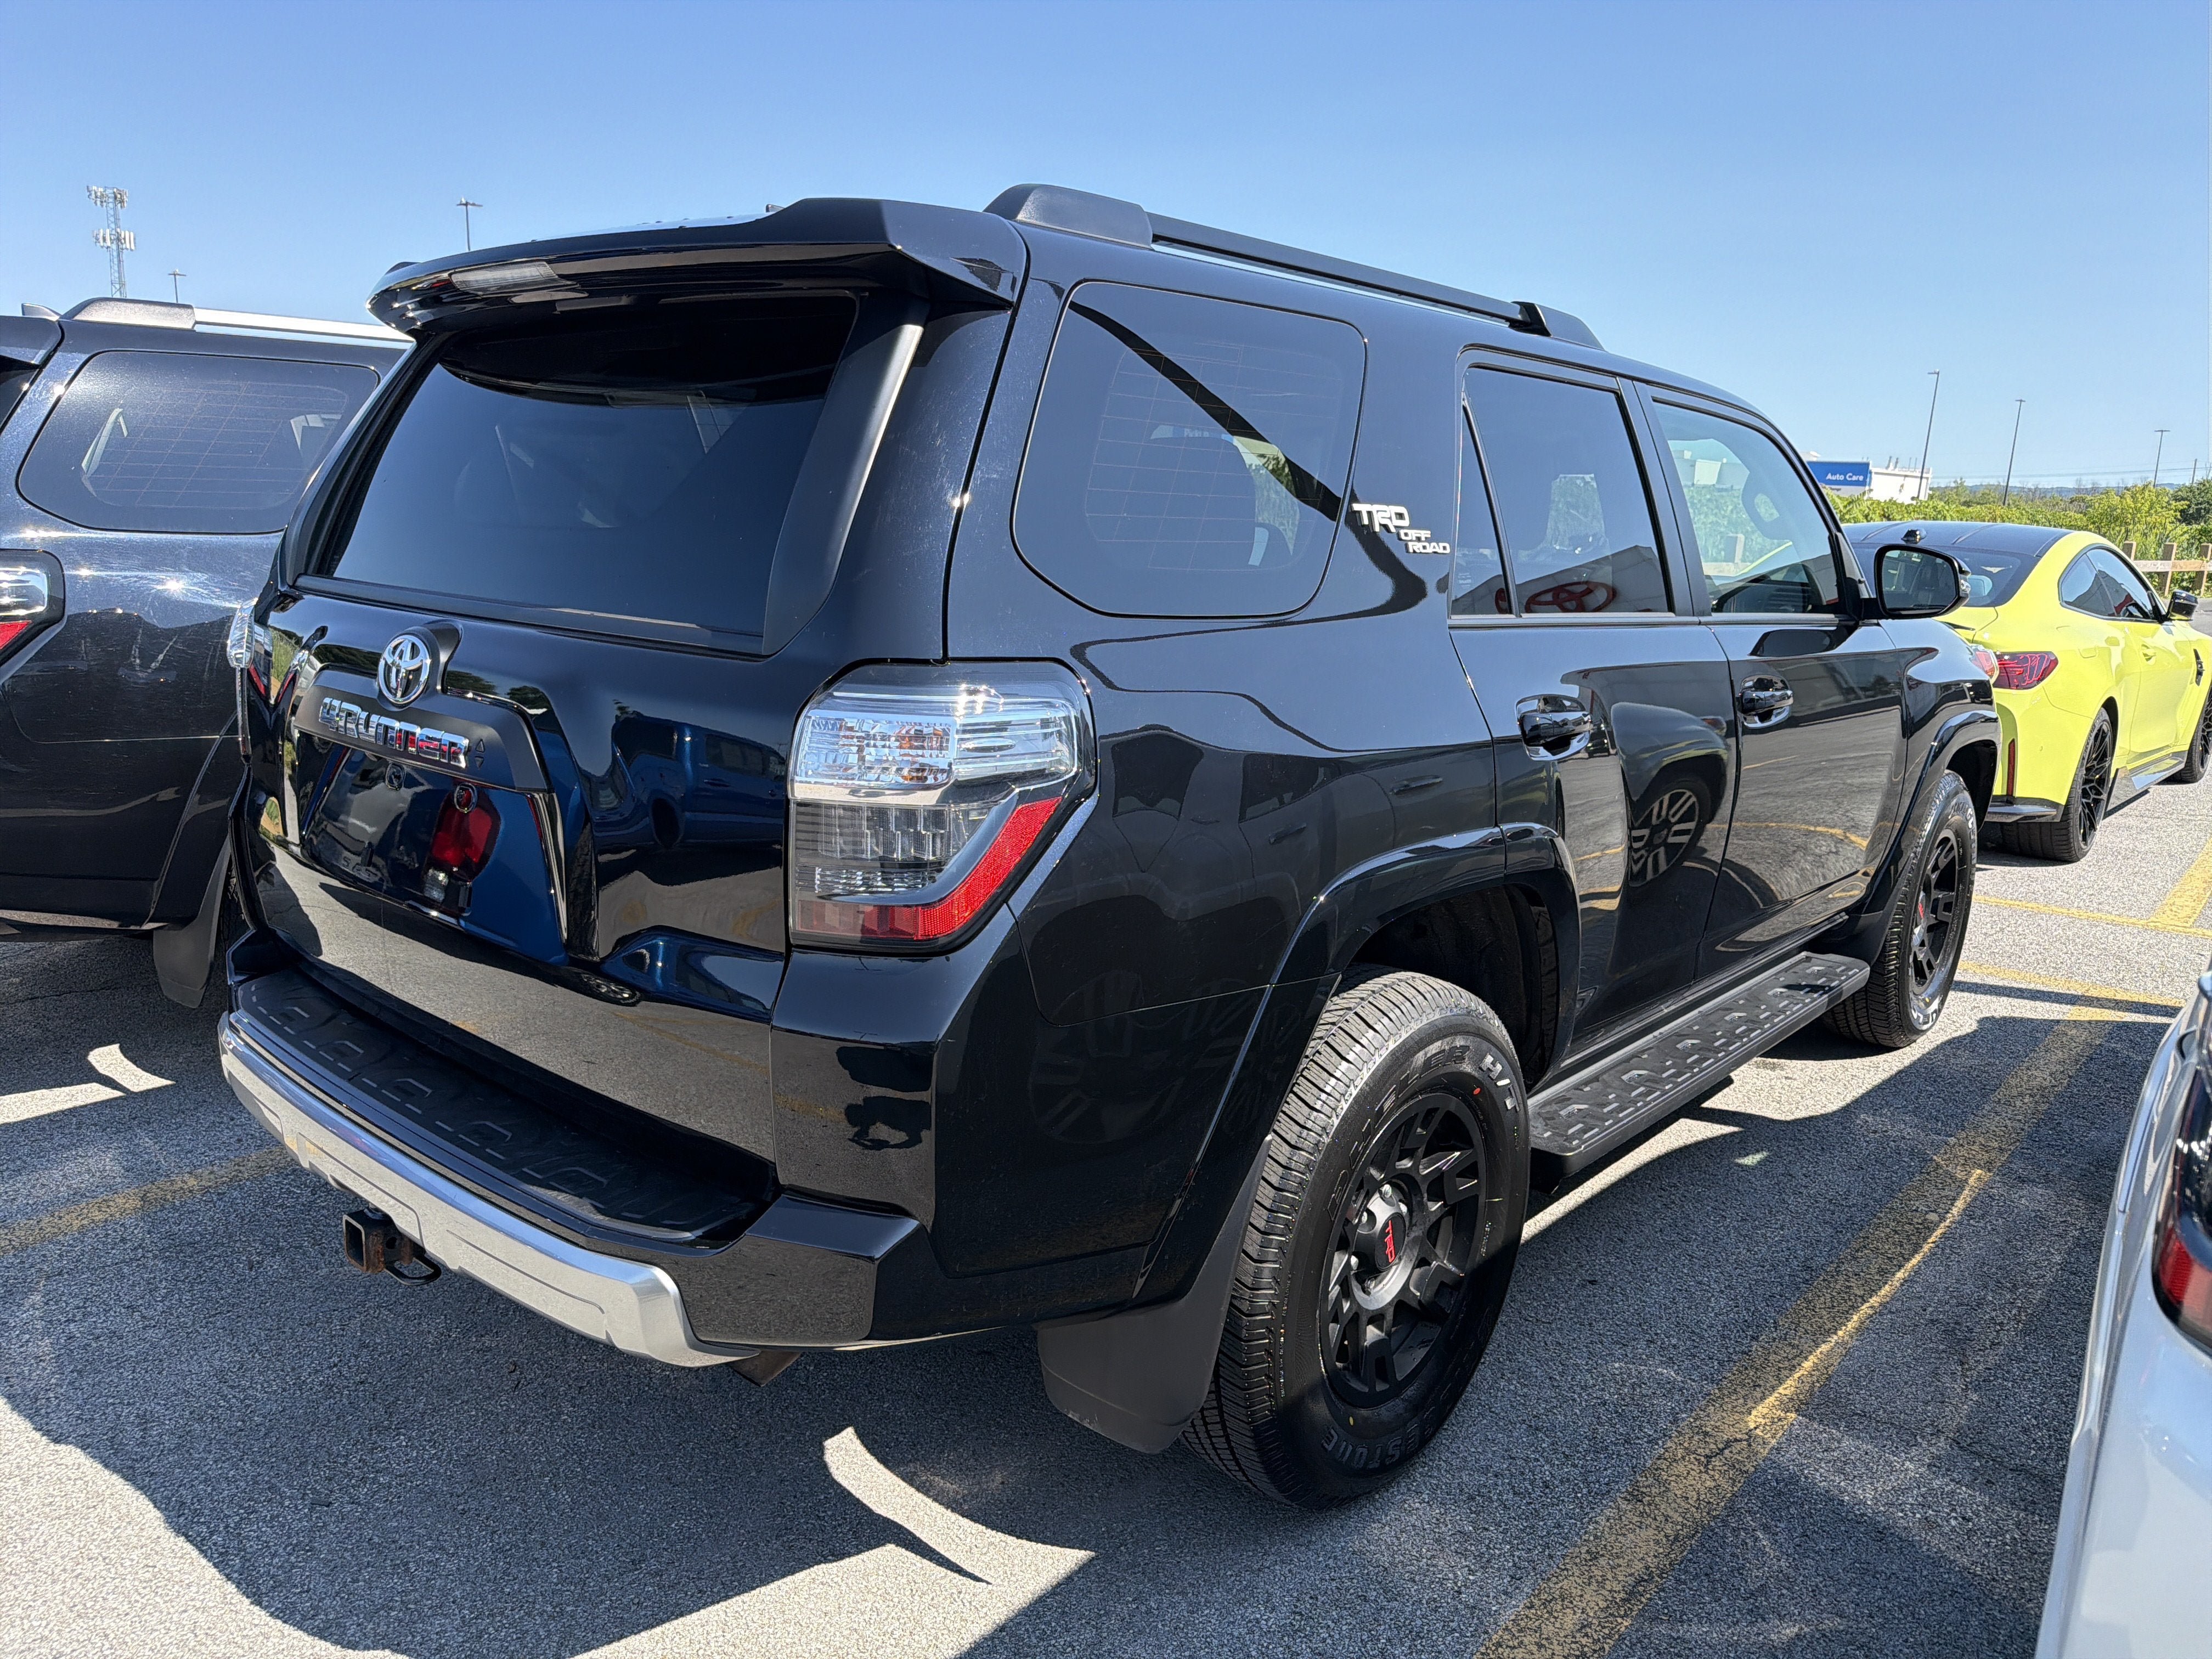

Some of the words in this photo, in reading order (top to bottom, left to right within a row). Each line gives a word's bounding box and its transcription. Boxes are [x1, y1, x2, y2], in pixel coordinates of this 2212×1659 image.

[1826, 472, 1844, 481] Auto
[1846, 473, 1864, 481] Care
[1351, 503, 1410, 533] TRD
[1398, 528, 1431, 541] OFF
[1406, 541, 1451, 554] ROAD
[1384, 1220, 1396, 1263] TRD
